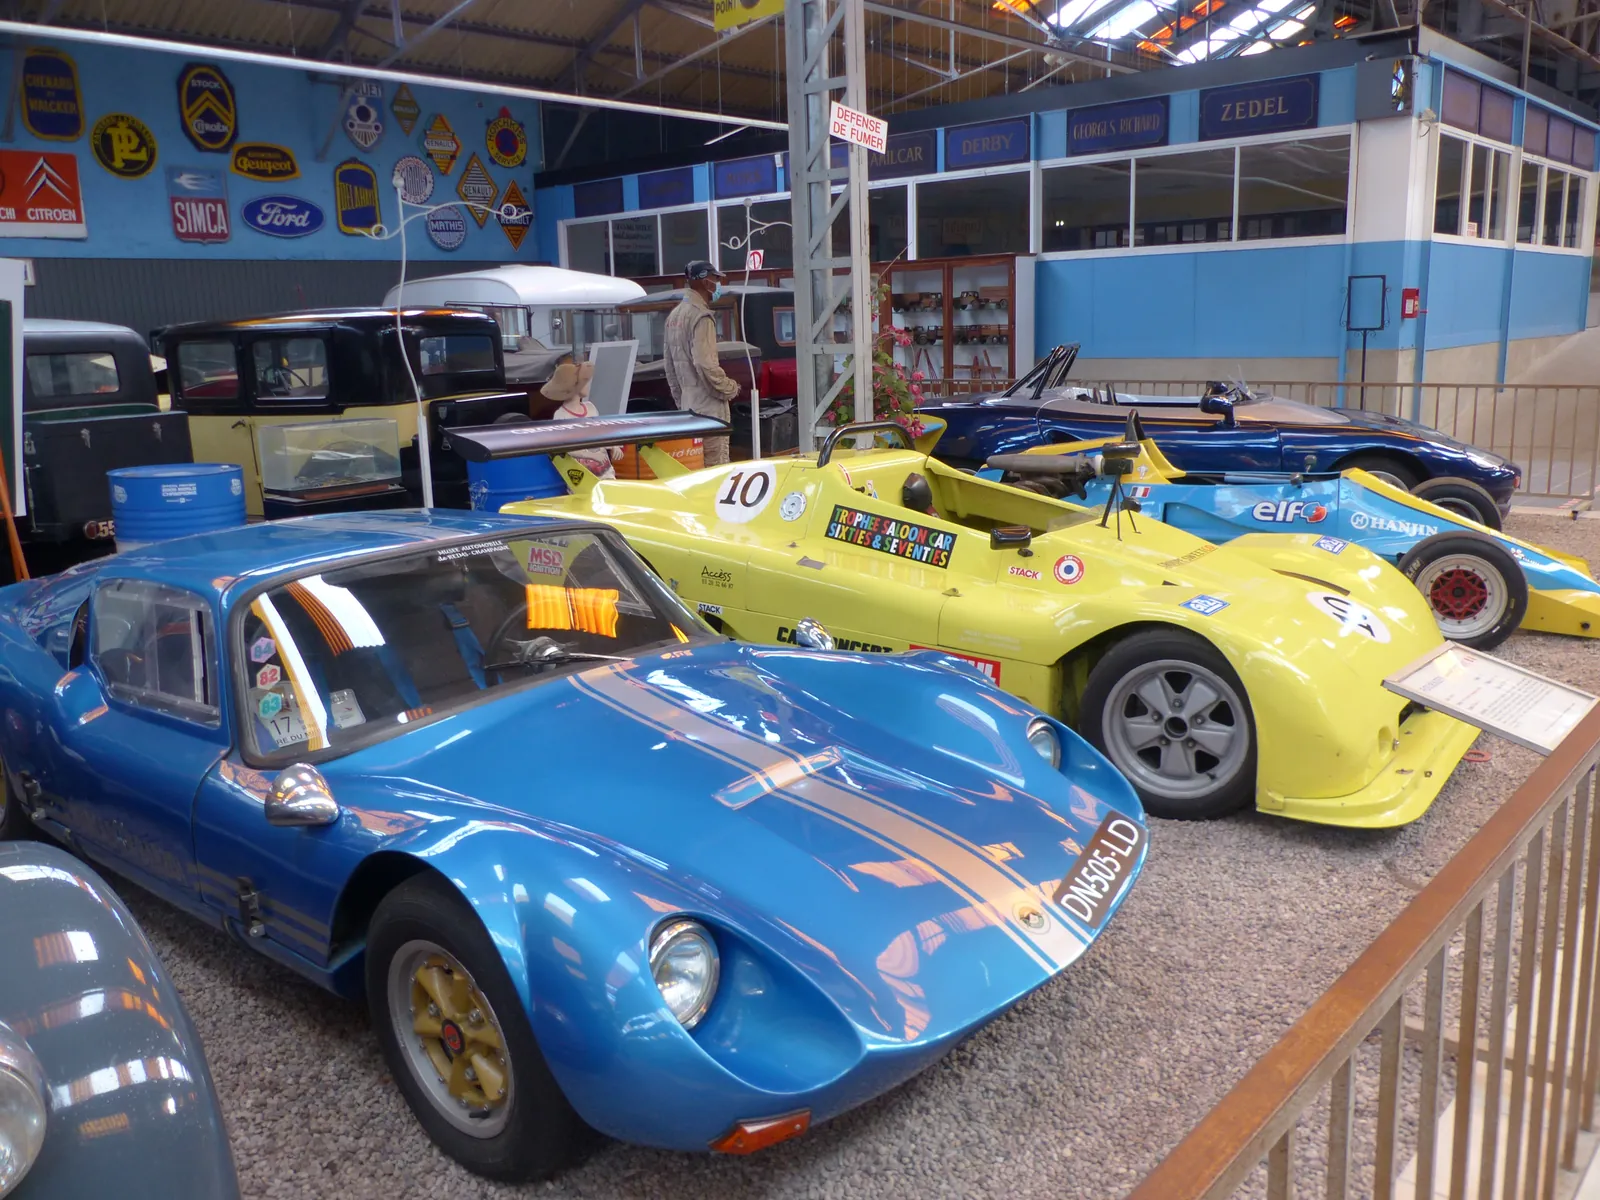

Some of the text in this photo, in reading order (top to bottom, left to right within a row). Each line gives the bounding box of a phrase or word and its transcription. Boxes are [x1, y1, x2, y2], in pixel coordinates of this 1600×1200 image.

[1221, 97, 1288, 123] ZEDEL
[837, 107, 881, 134] DEFENSE
[1073, 113, 1160, 140] GEORGES RICHARD
[488, 118, 527, 145] HOTCHKISS
[833, 121, 884, 151] DE FUMER
[426, 140, 455, 149] RENAULT
[962, 133, 1013, 156] DERBY
[237, 156, 292, 174] Peugeot
[495, 152, 521, 165] SERVICE
[870, 147, 923, 167] AMILCAR
[464, 185, 492, 196] RENAULT
[27, 206, 77, 221] CITROEN
[174, 202, 229, 234] SIMCA
[256, 202, 310, 227] Ford
[430, 220, 463, 231] MATHIS
[719, 471, 769, 508] 10
[1253, 501, 1304, 522] elf
[834, 508, 953, 551] TROPHEE SALOON CAR
[1371, 517, 1438, 537] HANJIN
[461, 541, 503, 552] AUTOMOBILE
[829, 523, 949, 567] SIXTIES & SEVENTIES
[530, 547, 563, 566] MSD
[528, 563, 563, 576] IGNITION
[701, 565, 732, 582] Accèss
[1009, 566, 1039, 580] STACK
[698, 603, 721, 614] STACK
[777, 627, 797, 645] CA
[255, 642, 272, 659] 84
[260, 668, 278, 686] 82
[262, 696, 279, 715] 83
[270, 716, 290, 735] 17
